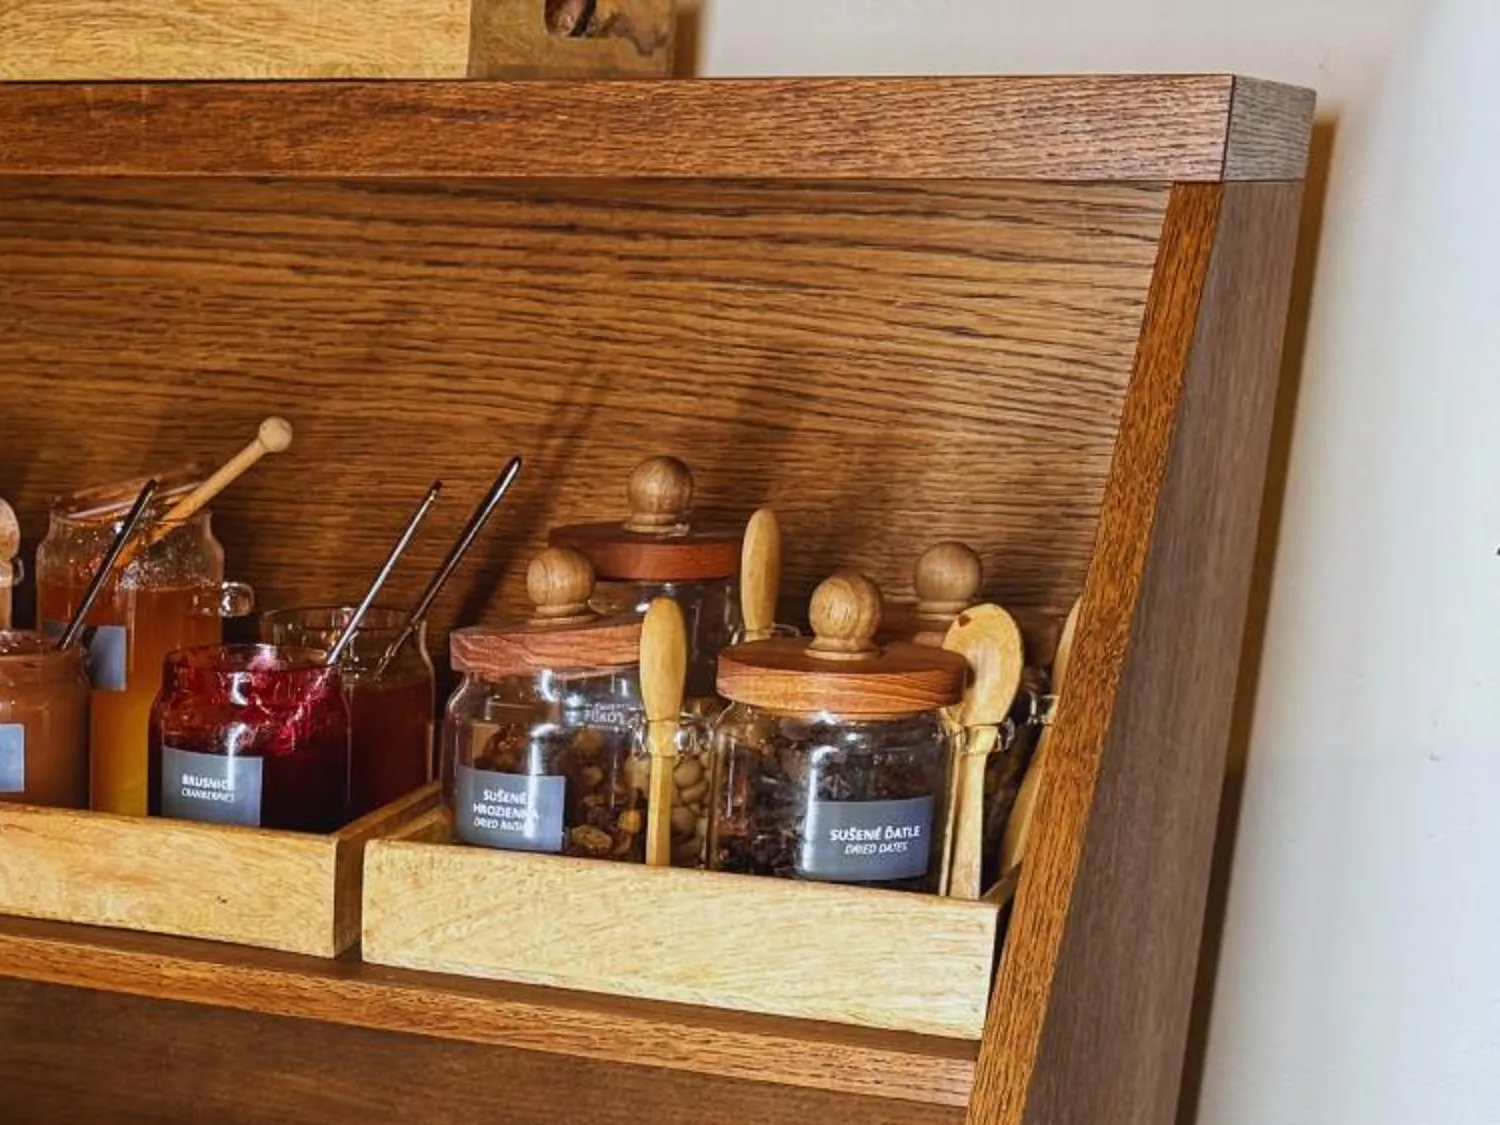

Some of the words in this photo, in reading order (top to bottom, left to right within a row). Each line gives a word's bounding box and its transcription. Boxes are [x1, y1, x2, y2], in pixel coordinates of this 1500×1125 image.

[483, 788, 528, 805] SUŠENÉ
[472, 802, 540, 820] HROZIENA
[829, 826, 882, 841] SUŠENÉ
